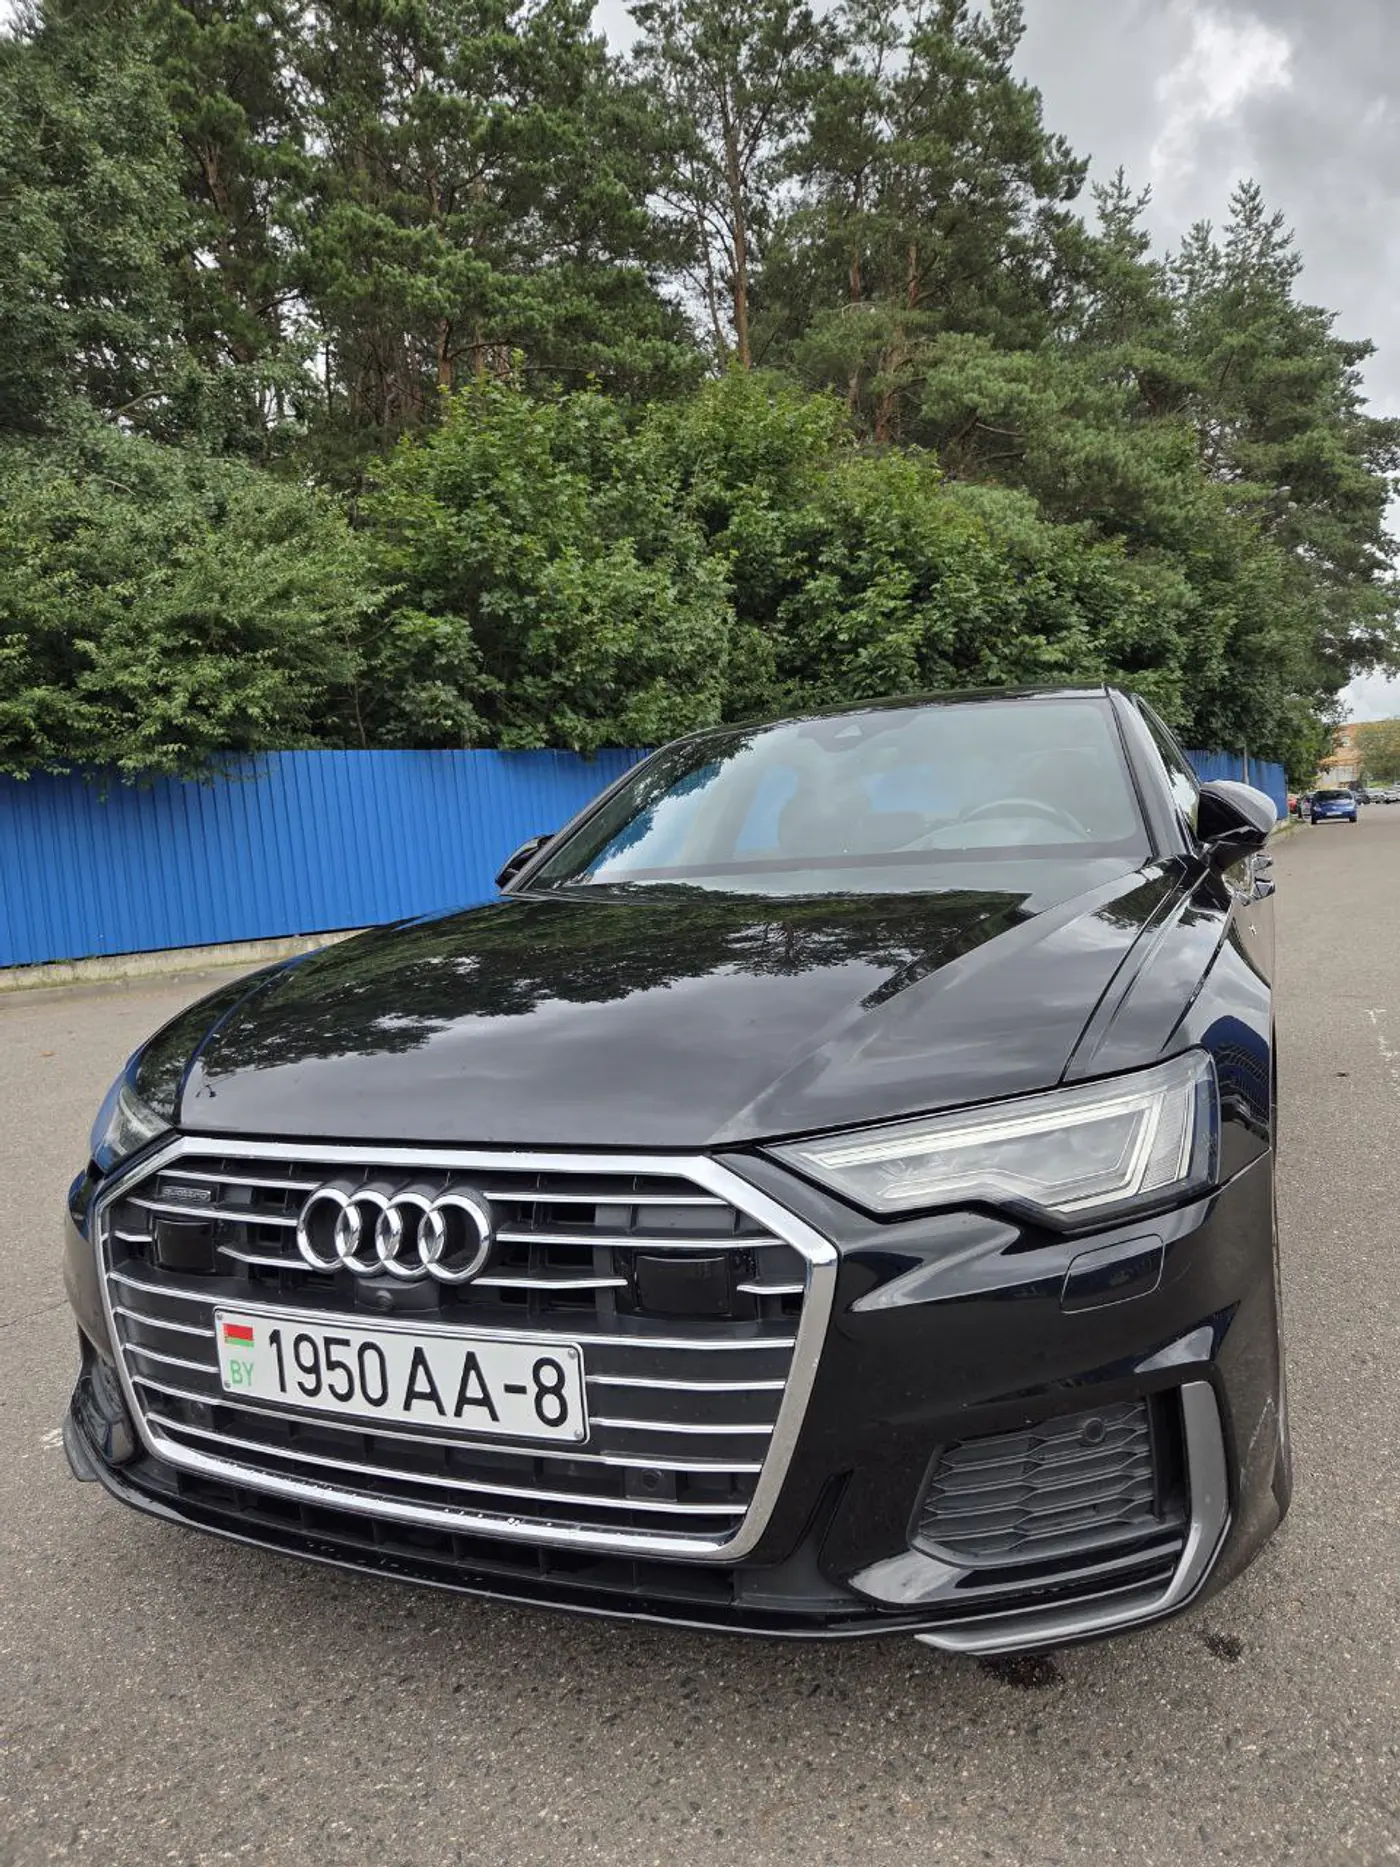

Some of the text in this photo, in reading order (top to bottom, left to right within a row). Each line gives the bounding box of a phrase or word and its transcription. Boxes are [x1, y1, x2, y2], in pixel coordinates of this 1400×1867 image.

[230, 1359, 254, 1386] BY
[268, 1329, 568, 1428] 1950 AA-8
